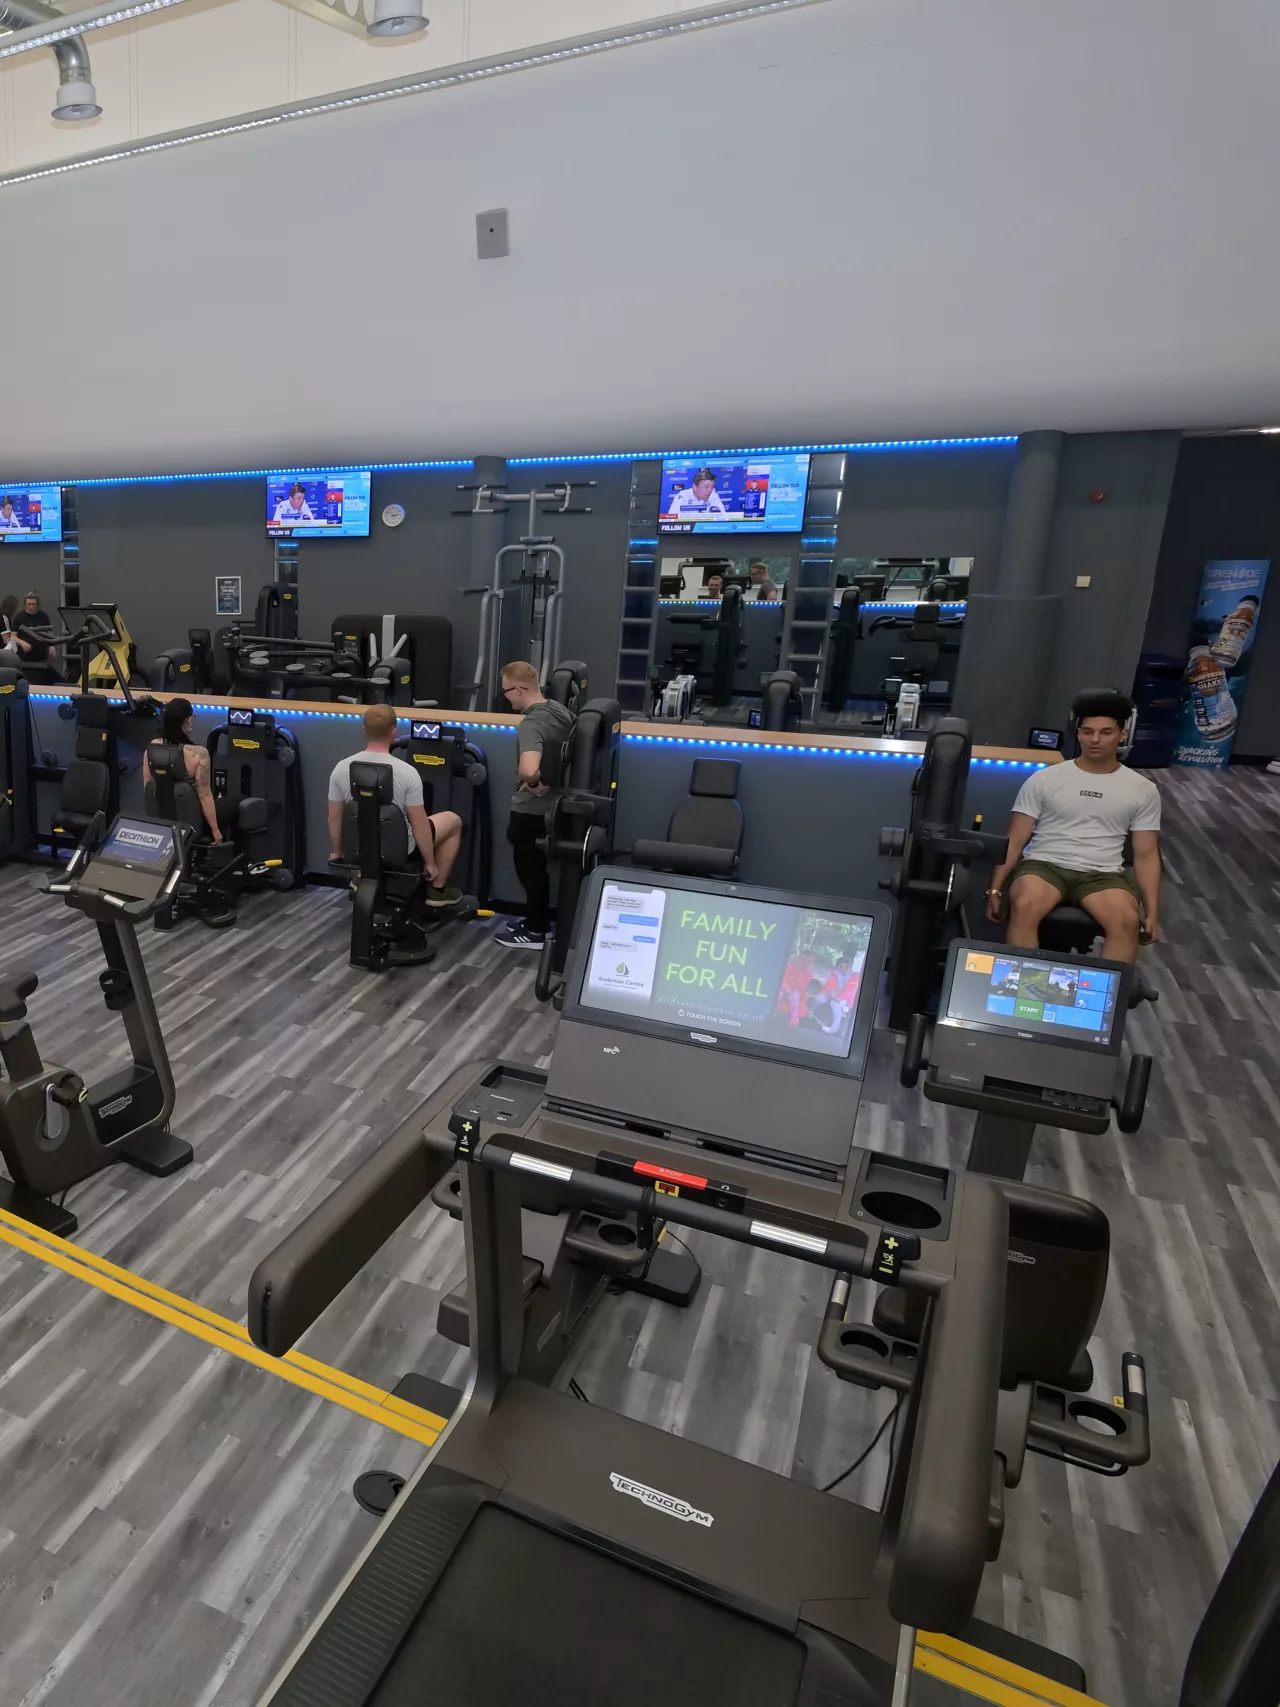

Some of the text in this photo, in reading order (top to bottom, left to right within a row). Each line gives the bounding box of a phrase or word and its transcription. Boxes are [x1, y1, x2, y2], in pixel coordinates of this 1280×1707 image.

[1178, 746, 1219, 757] SNACKING
[1177, 754, 1224, 765] REVOLUTION
[119, 831, 160, 845] DECATHLON
[680, 909, 777, 941] FAMILY
[695, 939, 748, 965] FUN
[598, 976, 625, 985] Anderton
[624, 979, 645, 988] Centre
[665, 962, 768, 998] FOR ALL
[1019, 1005, 1039, 1014] START
[686, 1011, 742, 1027] TOUCH THE SCREEN
[603, 1046, 616, 1055] NFC
[658, 1167, 683, 1177] STOP
[613, 1474, 710, 1523] TECHNOGYM
